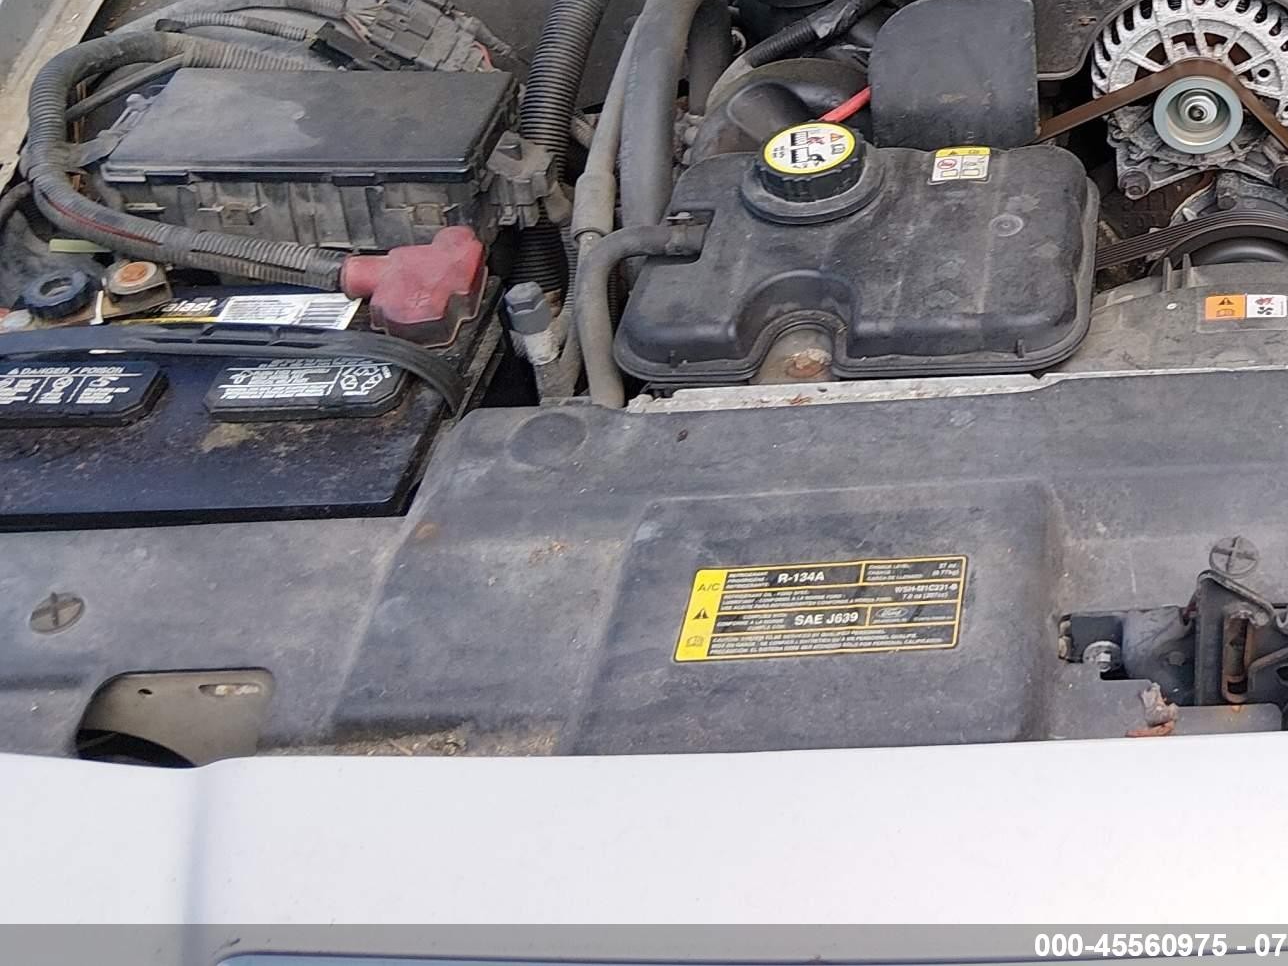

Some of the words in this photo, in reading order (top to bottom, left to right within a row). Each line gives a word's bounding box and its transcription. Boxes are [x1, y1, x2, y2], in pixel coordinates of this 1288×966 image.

[777, 571, 825, 584] R-134A
[697, 582, 721, 592] A/C
[794, 614, 824, 626] SAE
[826, 612, 859, 625] J639
